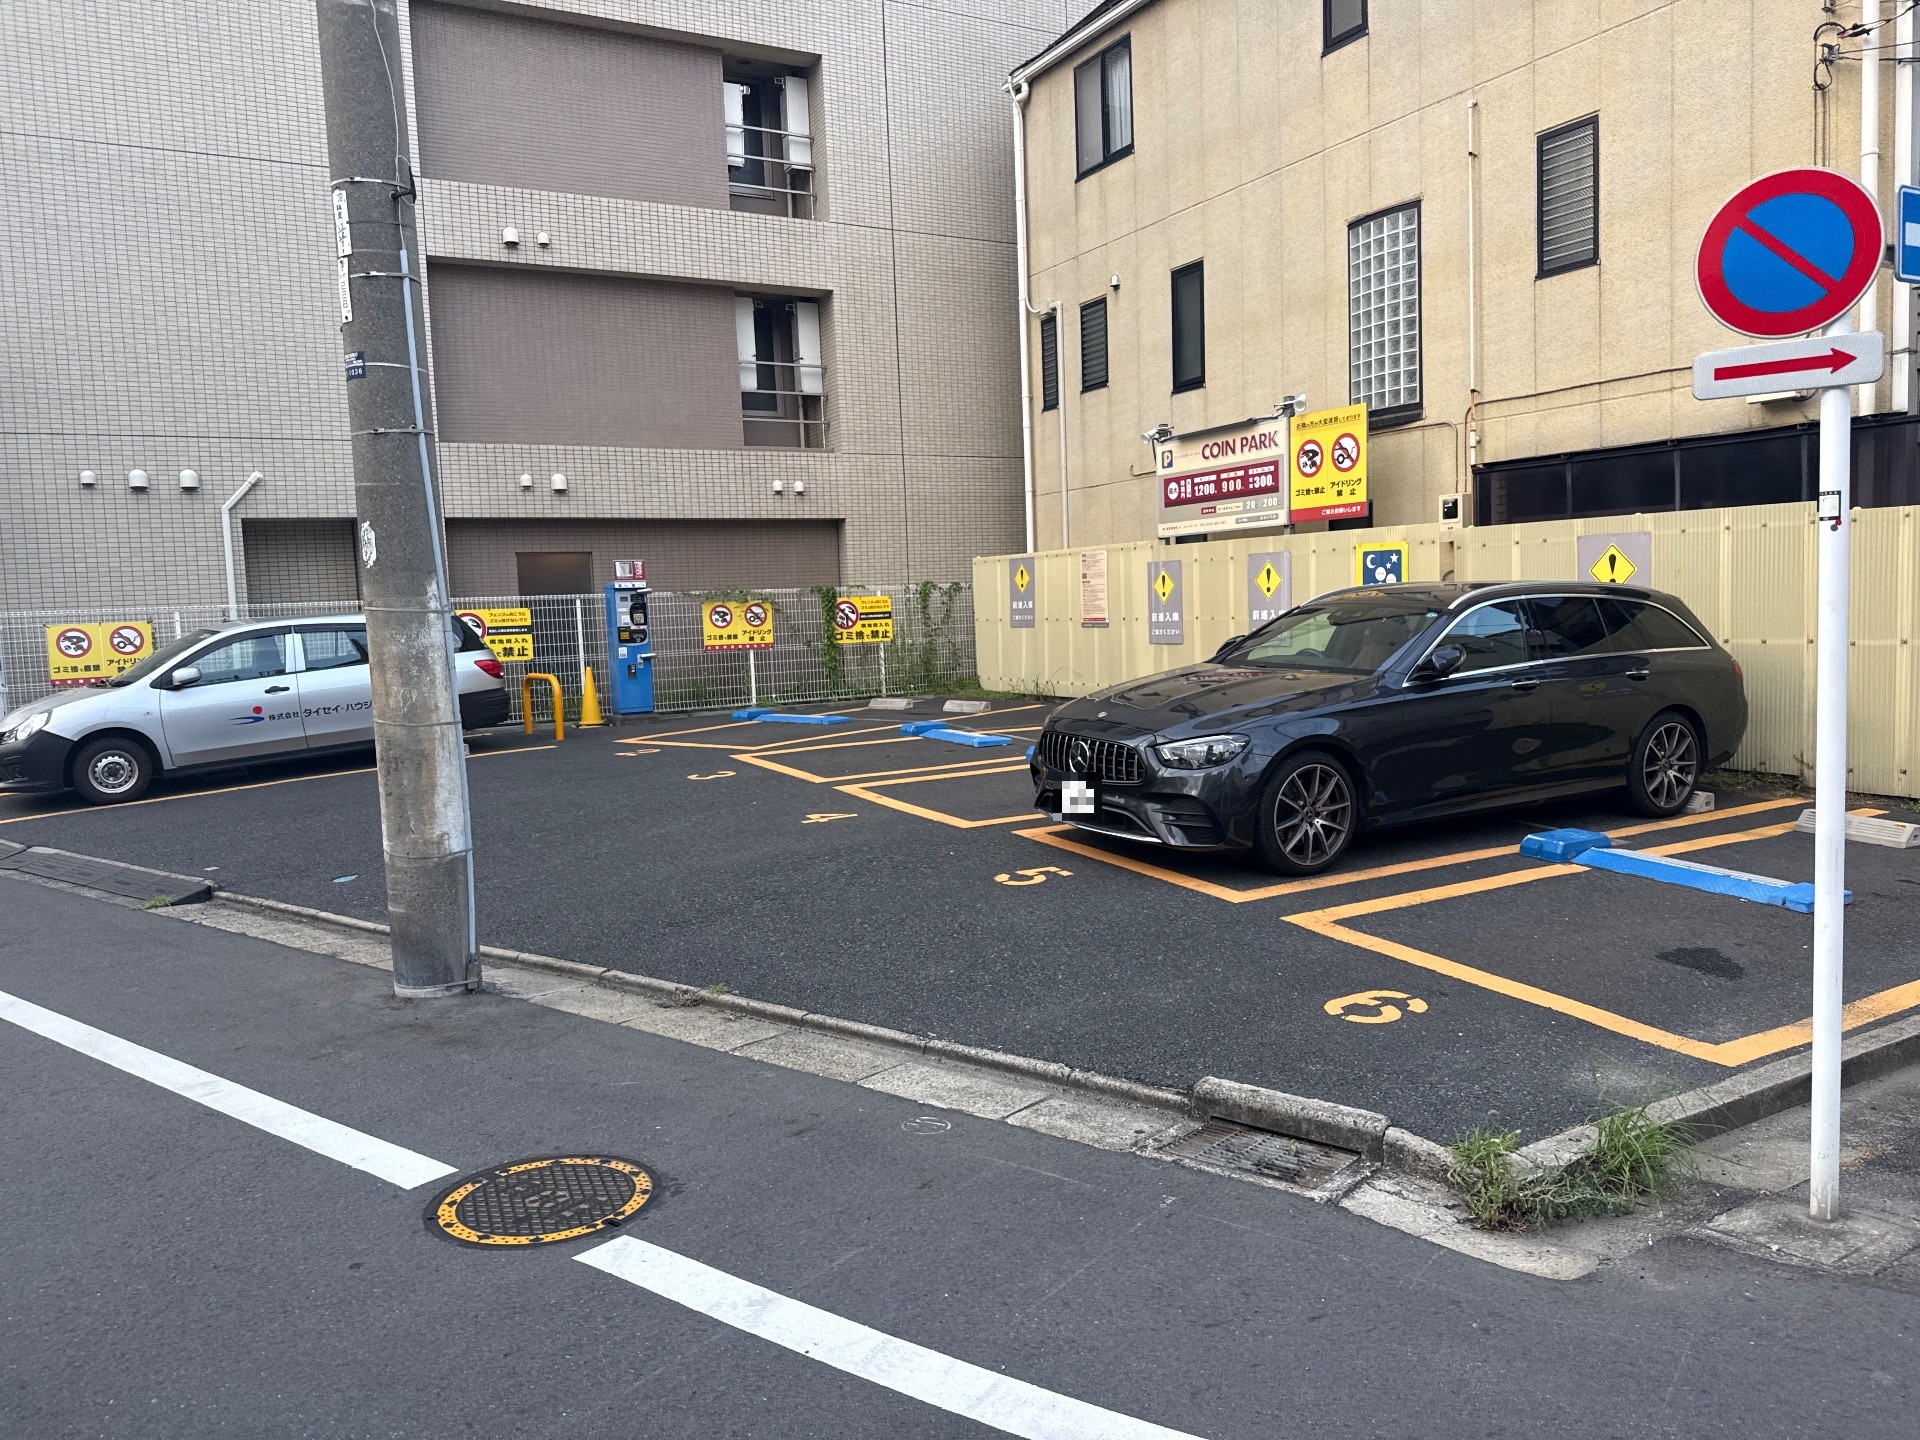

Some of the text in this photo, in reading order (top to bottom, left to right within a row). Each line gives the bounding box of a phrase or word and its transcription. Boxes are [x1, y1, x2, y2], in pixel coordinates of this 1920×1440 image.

[1202, 430, 1279, 460] COIN PARK
[1330, 478, 1362, 489] アイドリング
[1295, 487, 1325, 496] ゴミ捨て禁止
[1321, 506, 1361, 516] ご協力お願いします
[1012, 601, 1033, 609] 前進入庫
[1151, 611, 1179, 622] 前進入庫
[835, 629, 890, 641] ゴミ捨て禁止
[107, 657, 143, 666] アイドリ
[268, 700, 372, 721] 株式会社 タイセイ・ハウジ
[687, 770, 737, 780] 3
[801, 813, 858, 824] 4
[993, 866, 1074, 886] 5
[1323, 990, 1429, 1024] 6
